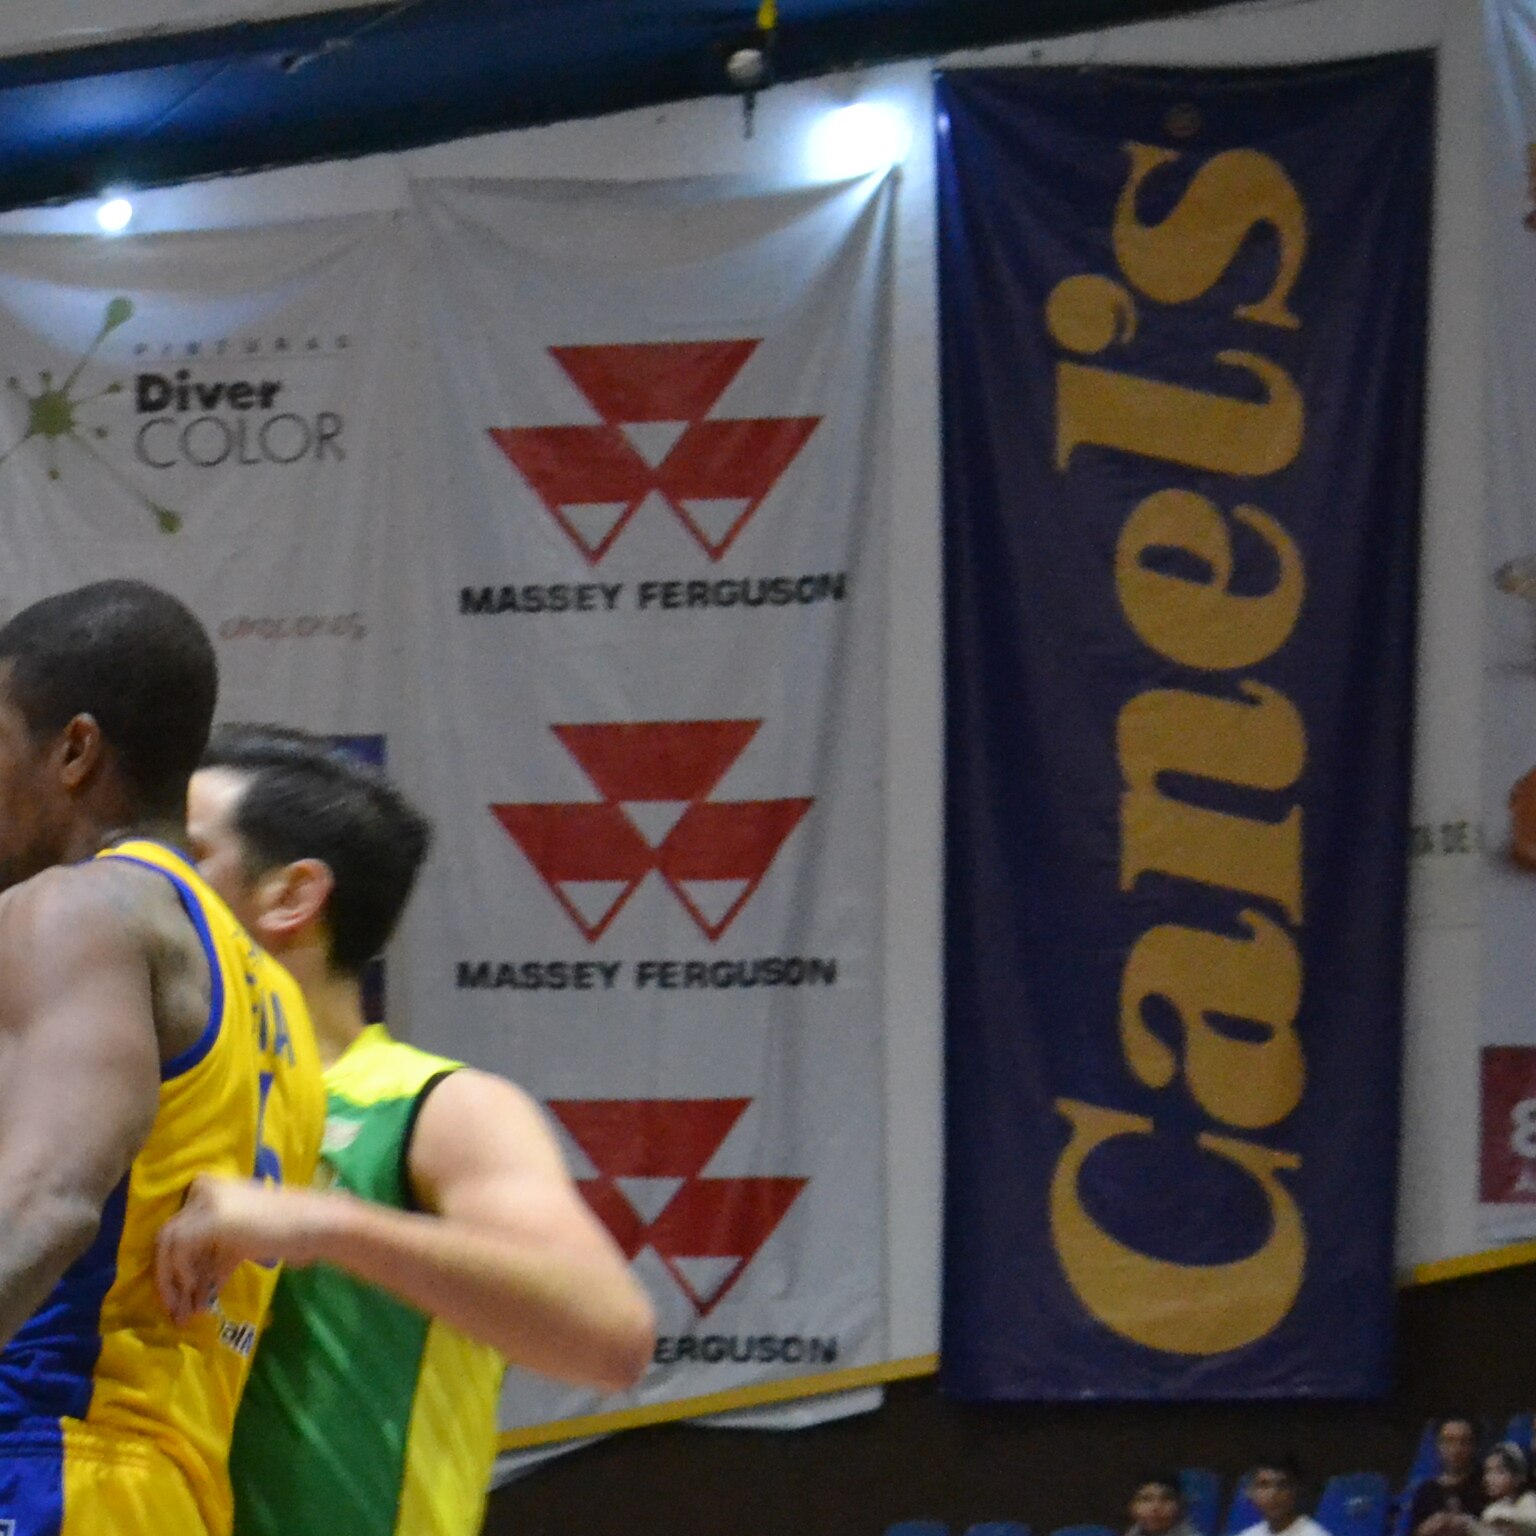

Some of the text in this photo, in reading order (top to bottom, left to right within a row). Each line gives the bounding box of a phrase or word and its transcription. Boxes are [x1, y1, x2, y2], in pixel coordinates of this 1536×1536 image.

[134, 368, 284, 413] Diver
[134, 411, 346, 468] COLOR
[458, 573, 848, 615] MASSEY FERGUSON
[1048, 142, 1308, 1357] Canel's
[454, 958, 838, 990] MASSEY FERGUSON
[653, 1333, 839, 1365] ERGUSON
